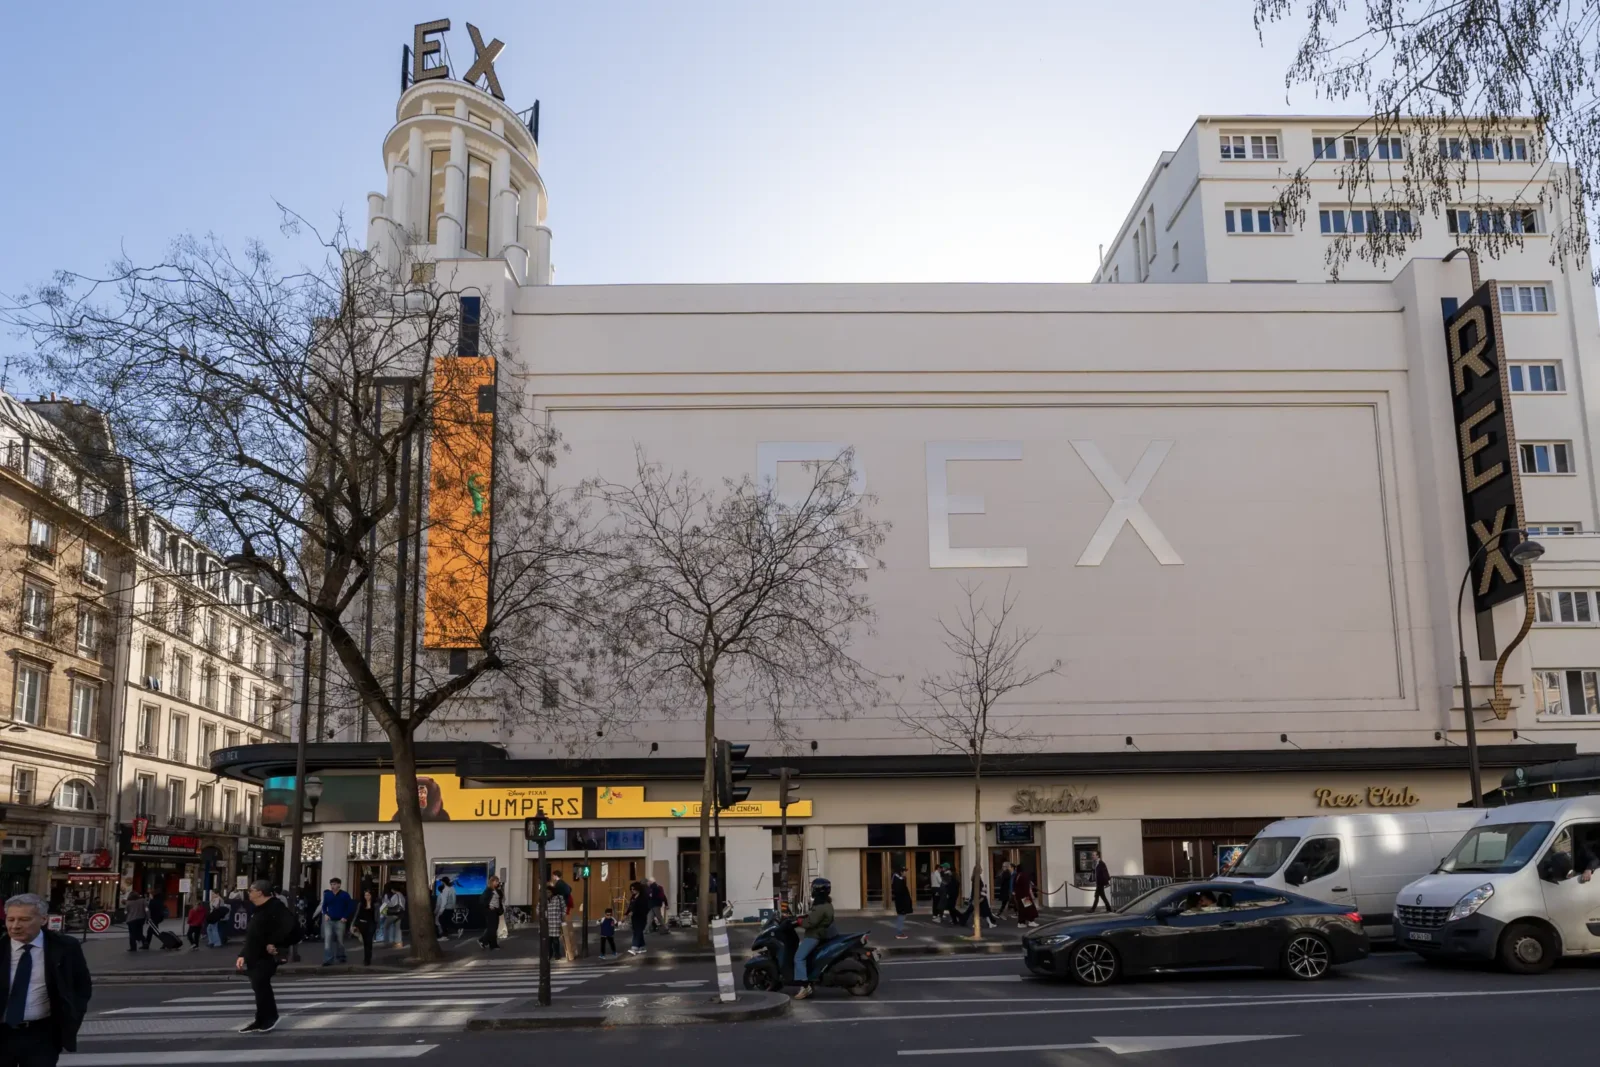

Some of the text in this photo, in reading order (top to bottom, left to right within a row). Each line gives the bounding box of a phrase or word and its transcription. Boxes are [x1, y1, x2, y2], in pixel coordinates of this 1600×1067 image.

[402, 18, 507, 101] EX
[1448, 303, 1519, 597] REX
[757, 439, 1185, 569] REX
[506, 789, 525, 797] Disney
[1010, 788, 1101, 815] Studios
[1314, 785, 1421, 808] Rex Club
[474, 798, 579, 817] JUMPERS
[736, 804, 760, 812] CINÉMA
